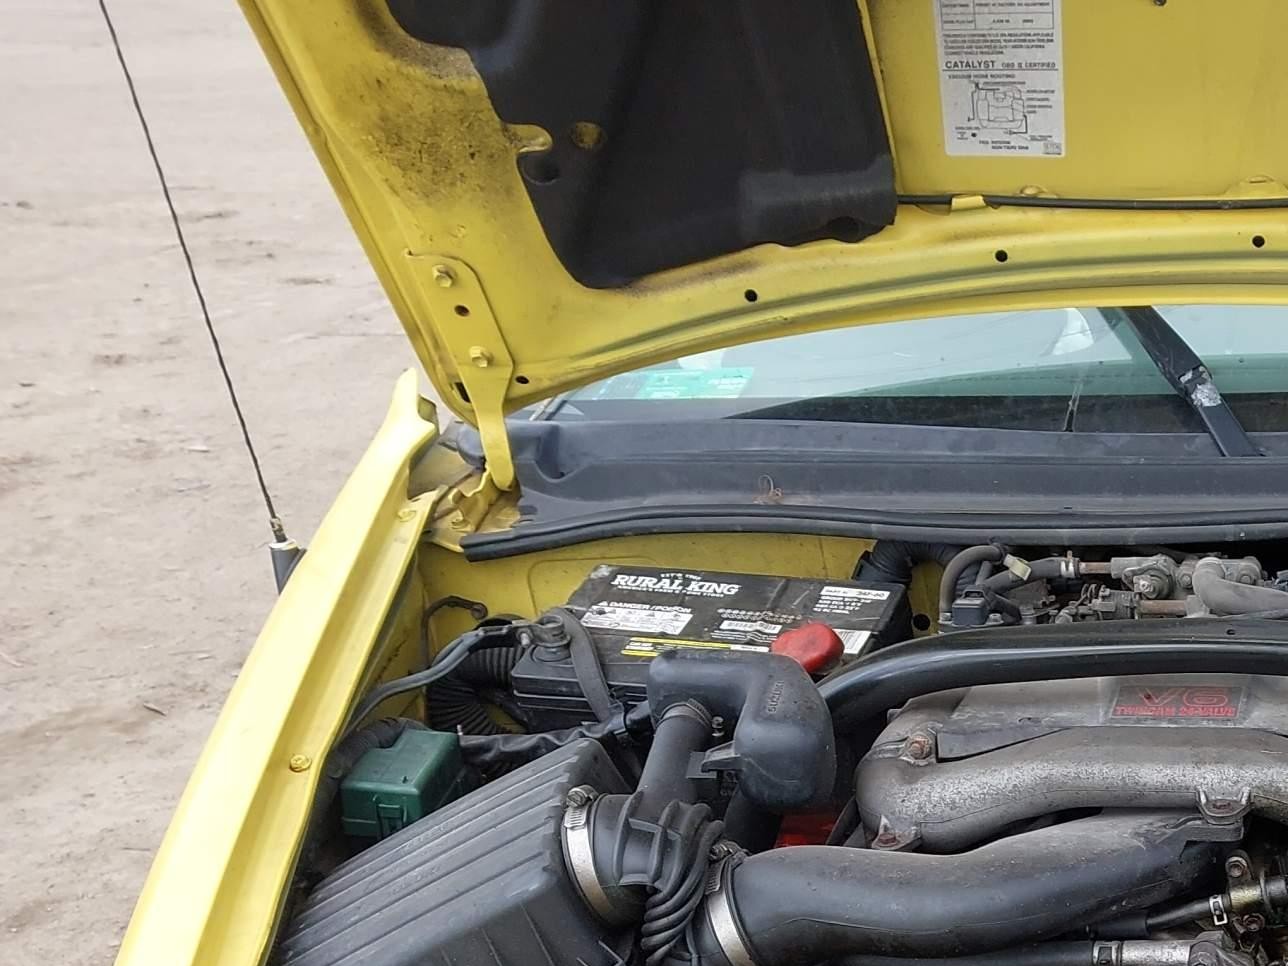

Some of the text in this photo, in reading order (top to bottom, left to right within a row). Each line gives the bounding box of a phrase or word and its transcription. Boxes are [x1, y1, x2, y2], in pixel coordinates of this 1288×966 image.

[945, 60, 995, 69] CATALYST
[611, 574, 742, 595] RURAL KING
[609, 601, 650, 610] DANGER
[767, 680, 785, 714] SUZUKI
[1137, 687, 1229, 706] V6
